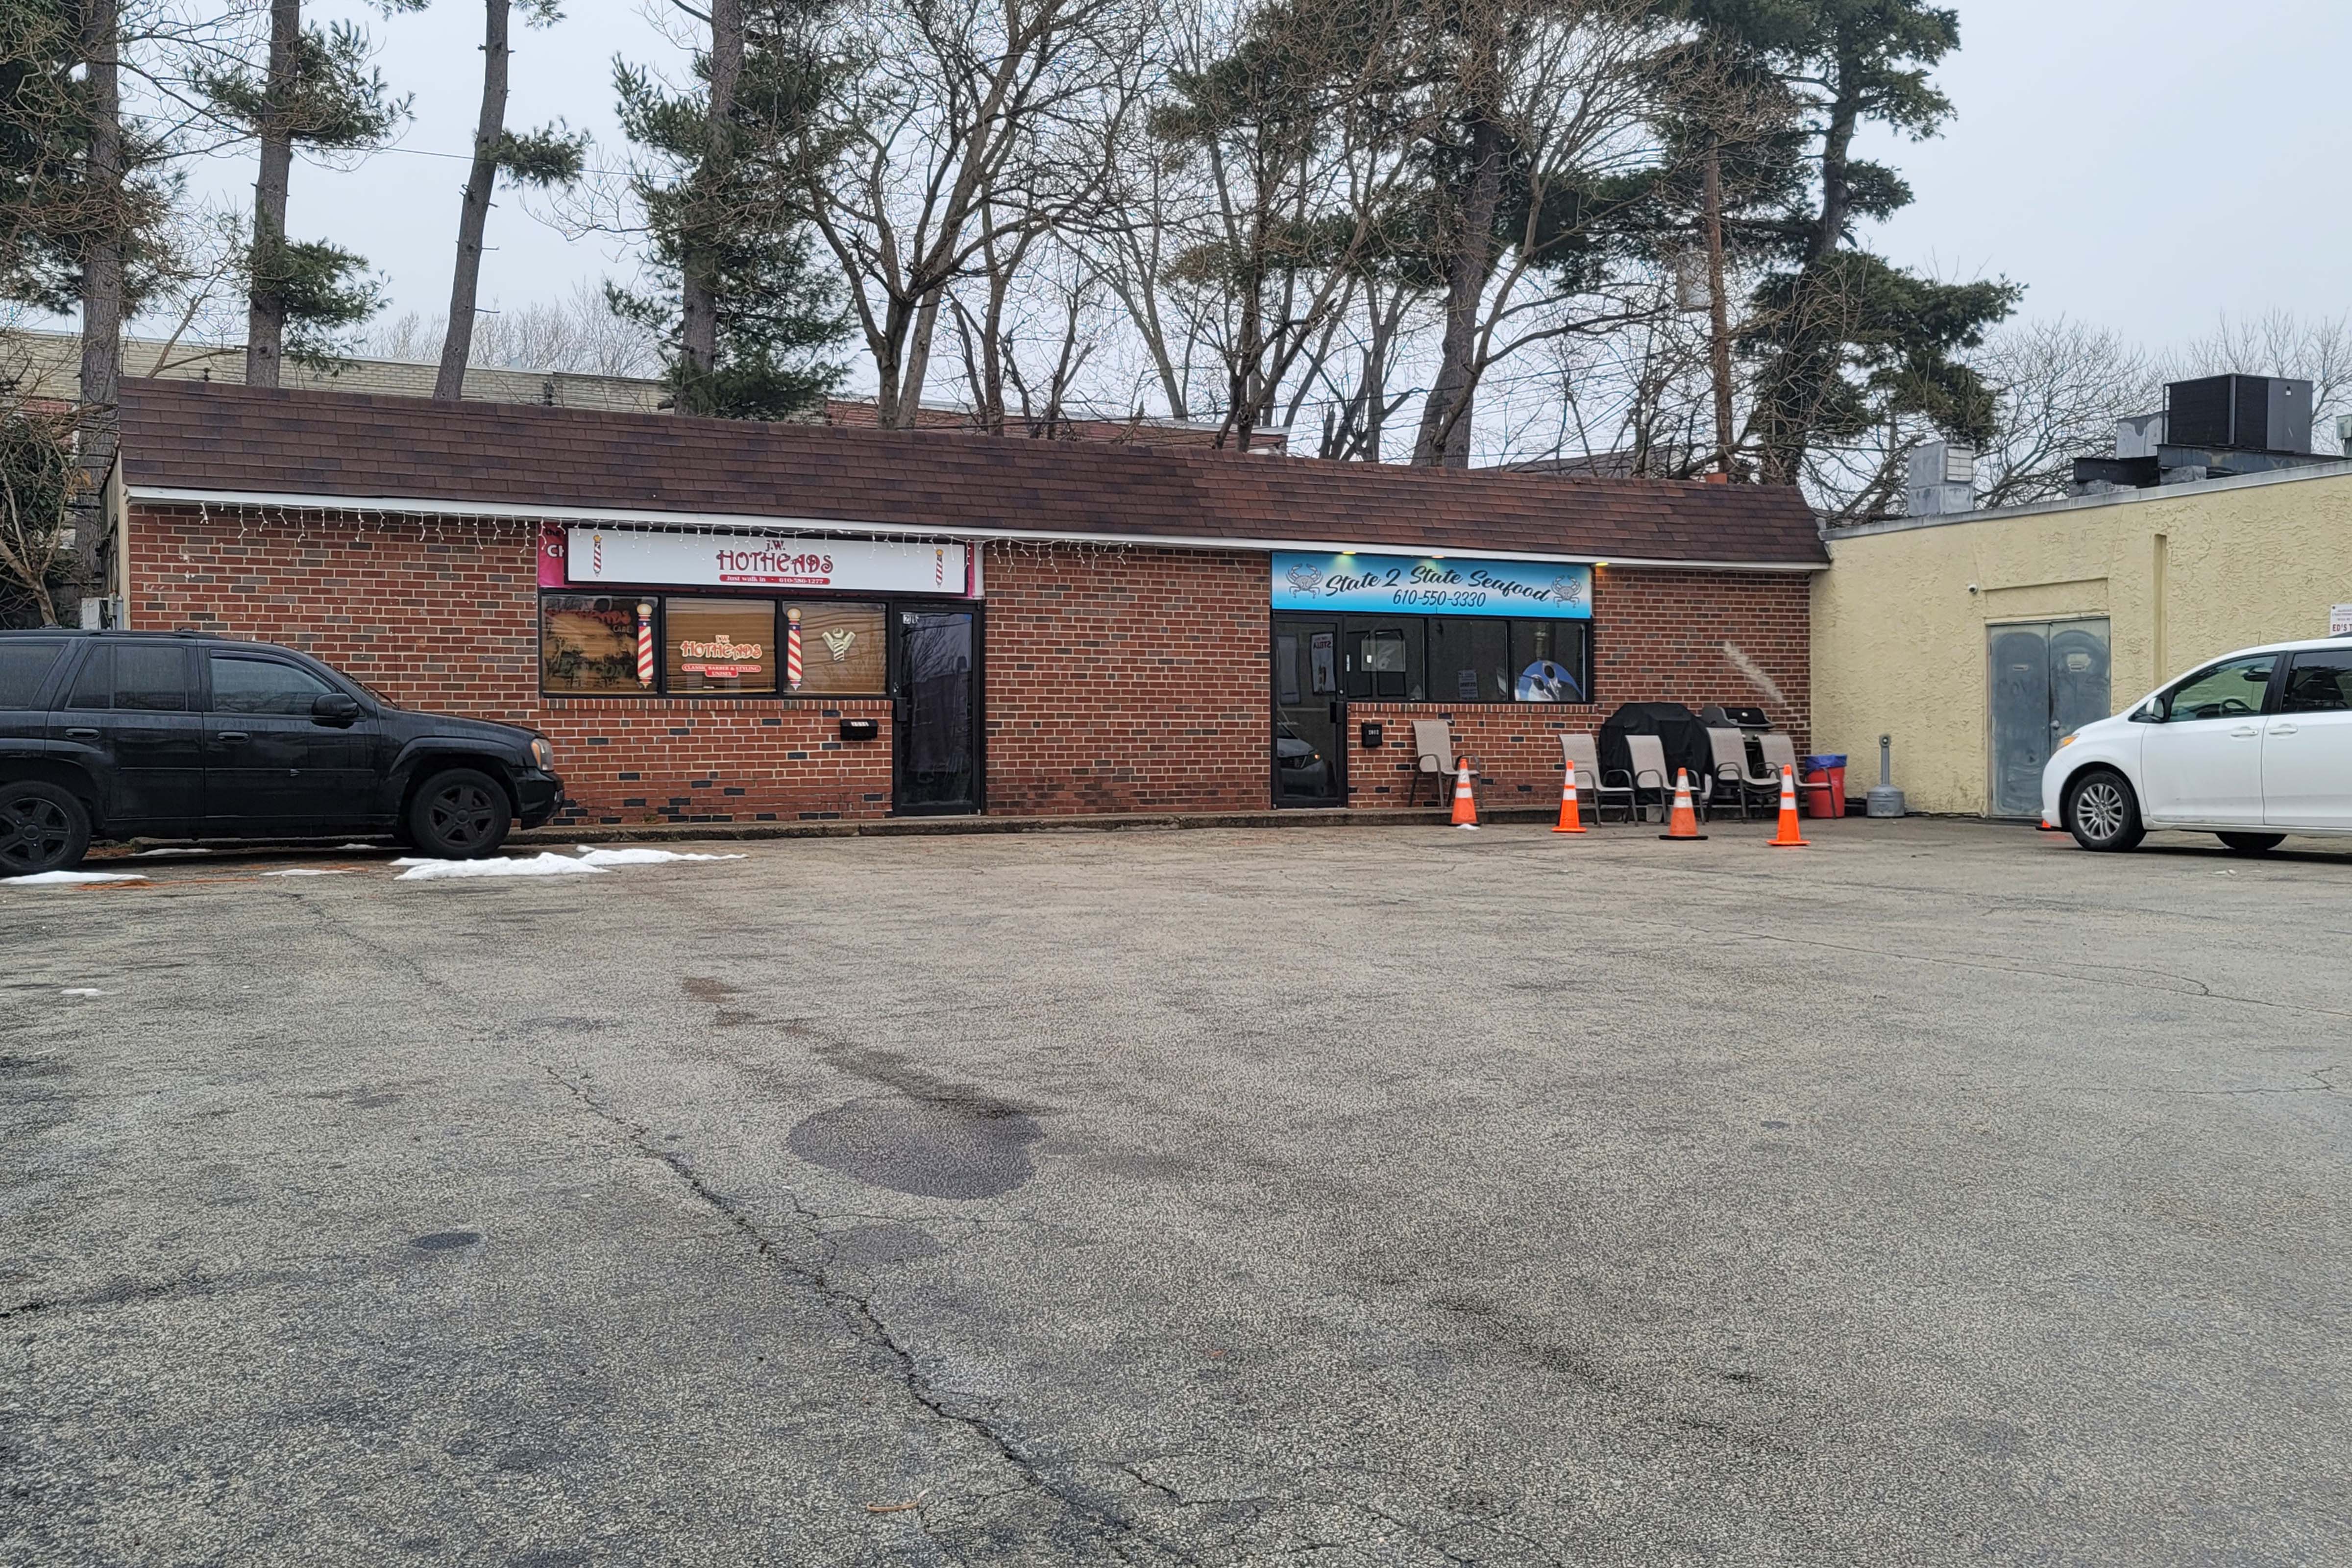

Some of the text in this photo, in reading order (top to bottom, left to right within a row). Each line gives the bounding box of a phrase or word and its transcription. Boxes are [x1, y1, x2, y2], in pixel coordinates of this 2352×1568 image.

[716, 550, 833, 575] HOTHEADS
[1325, 565, 1551, 602] State 2 State Seafood
[1393, 589, 1487, 607] 610-550-3330
[2332, 623, 2347, 632] ED'S
[681, 641, 762, 660] HOTHEADS
